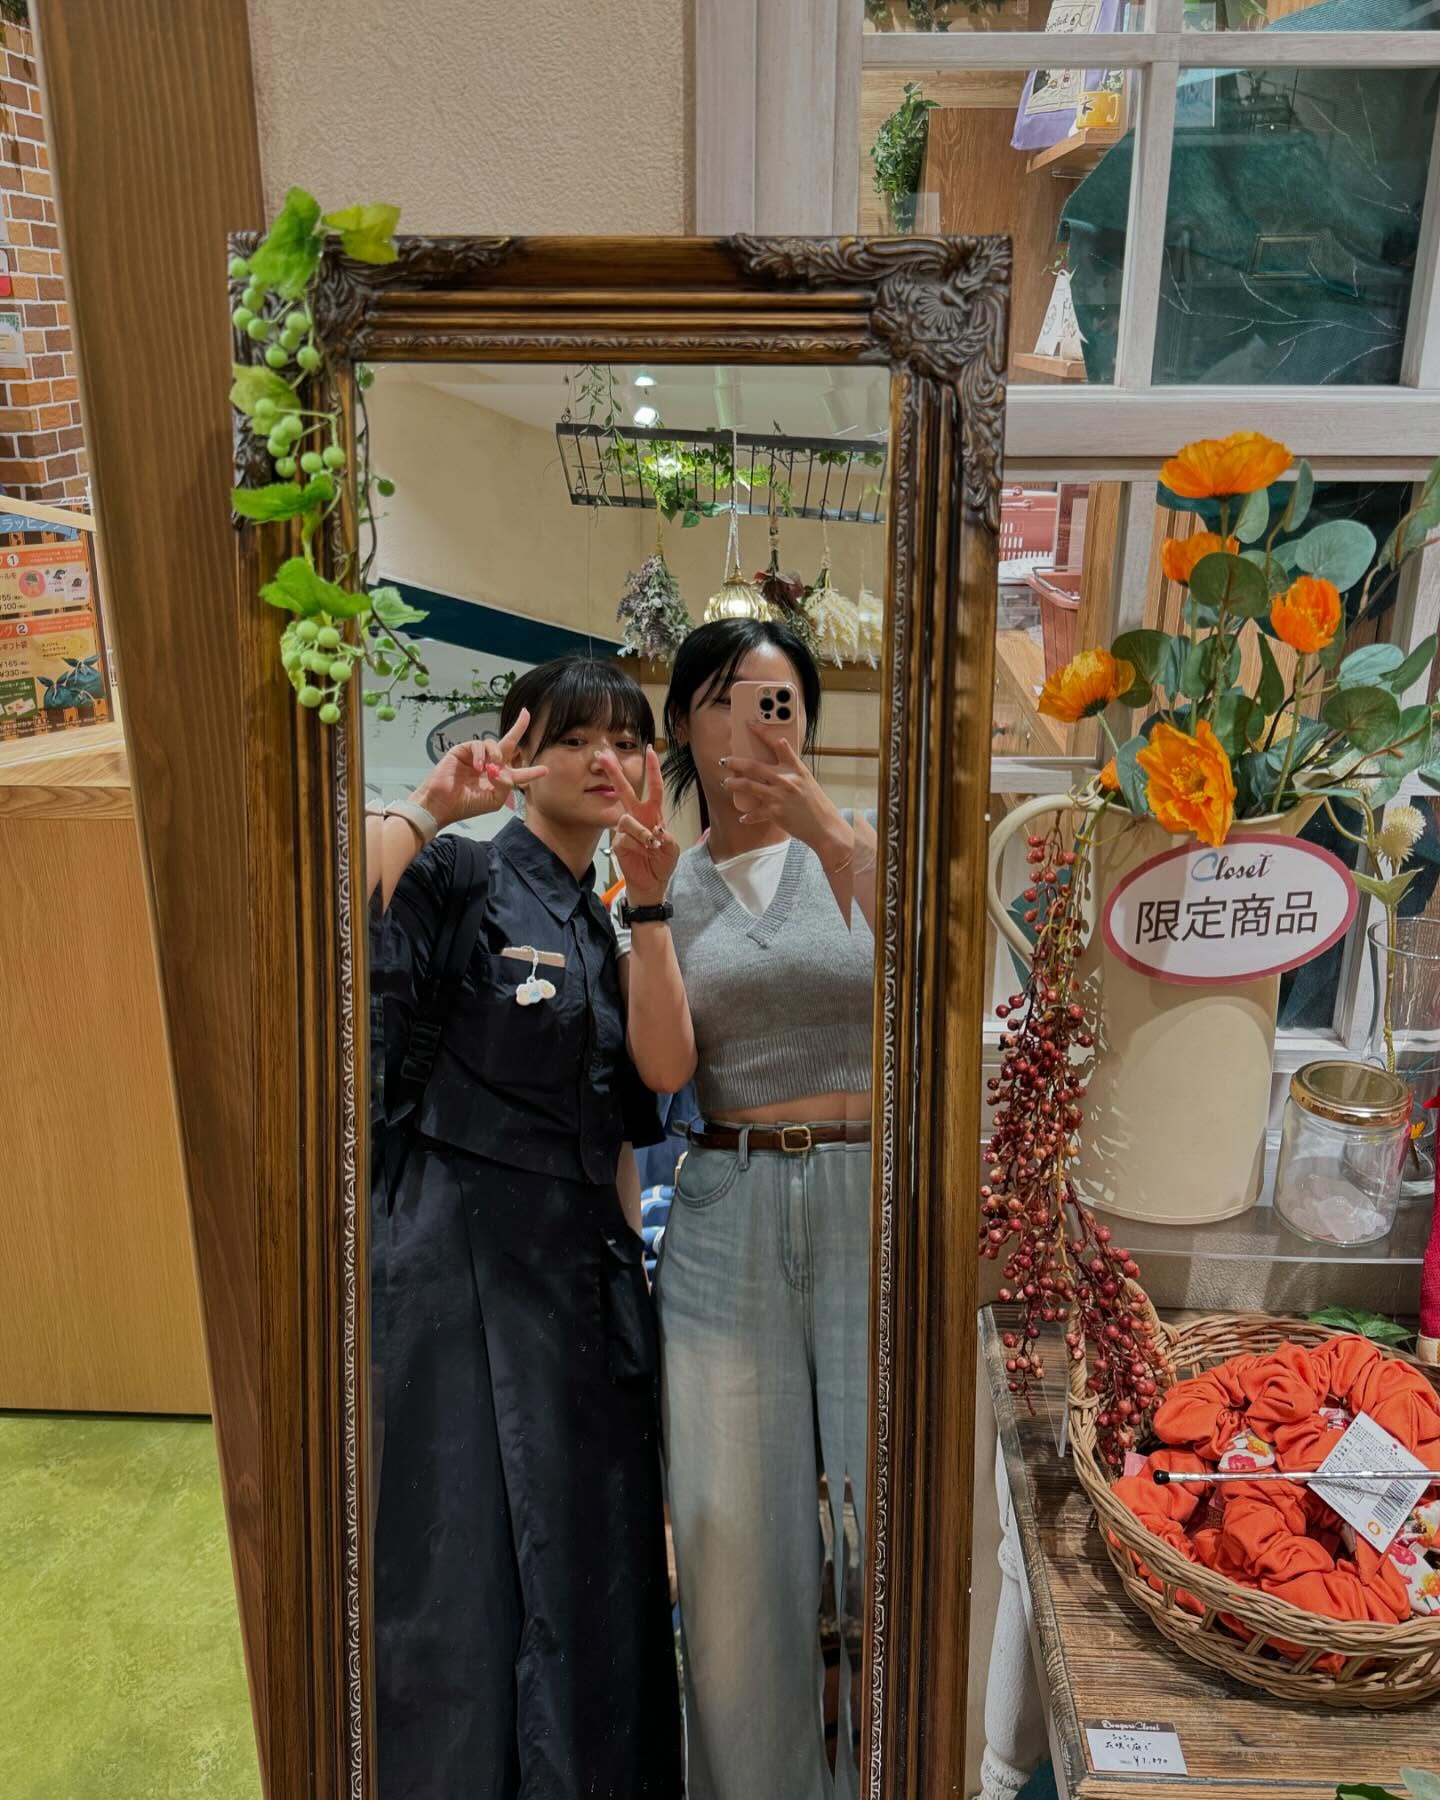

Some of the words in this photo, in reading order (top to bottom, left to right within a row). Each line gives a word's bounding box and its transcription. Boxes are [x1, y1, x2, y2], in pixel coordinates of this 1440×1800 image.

[2, 518, 60, 531] ラッピン
[1191, 852, 1274, 882] Closet
[1135, 890, 1318, 944] 限定商品
